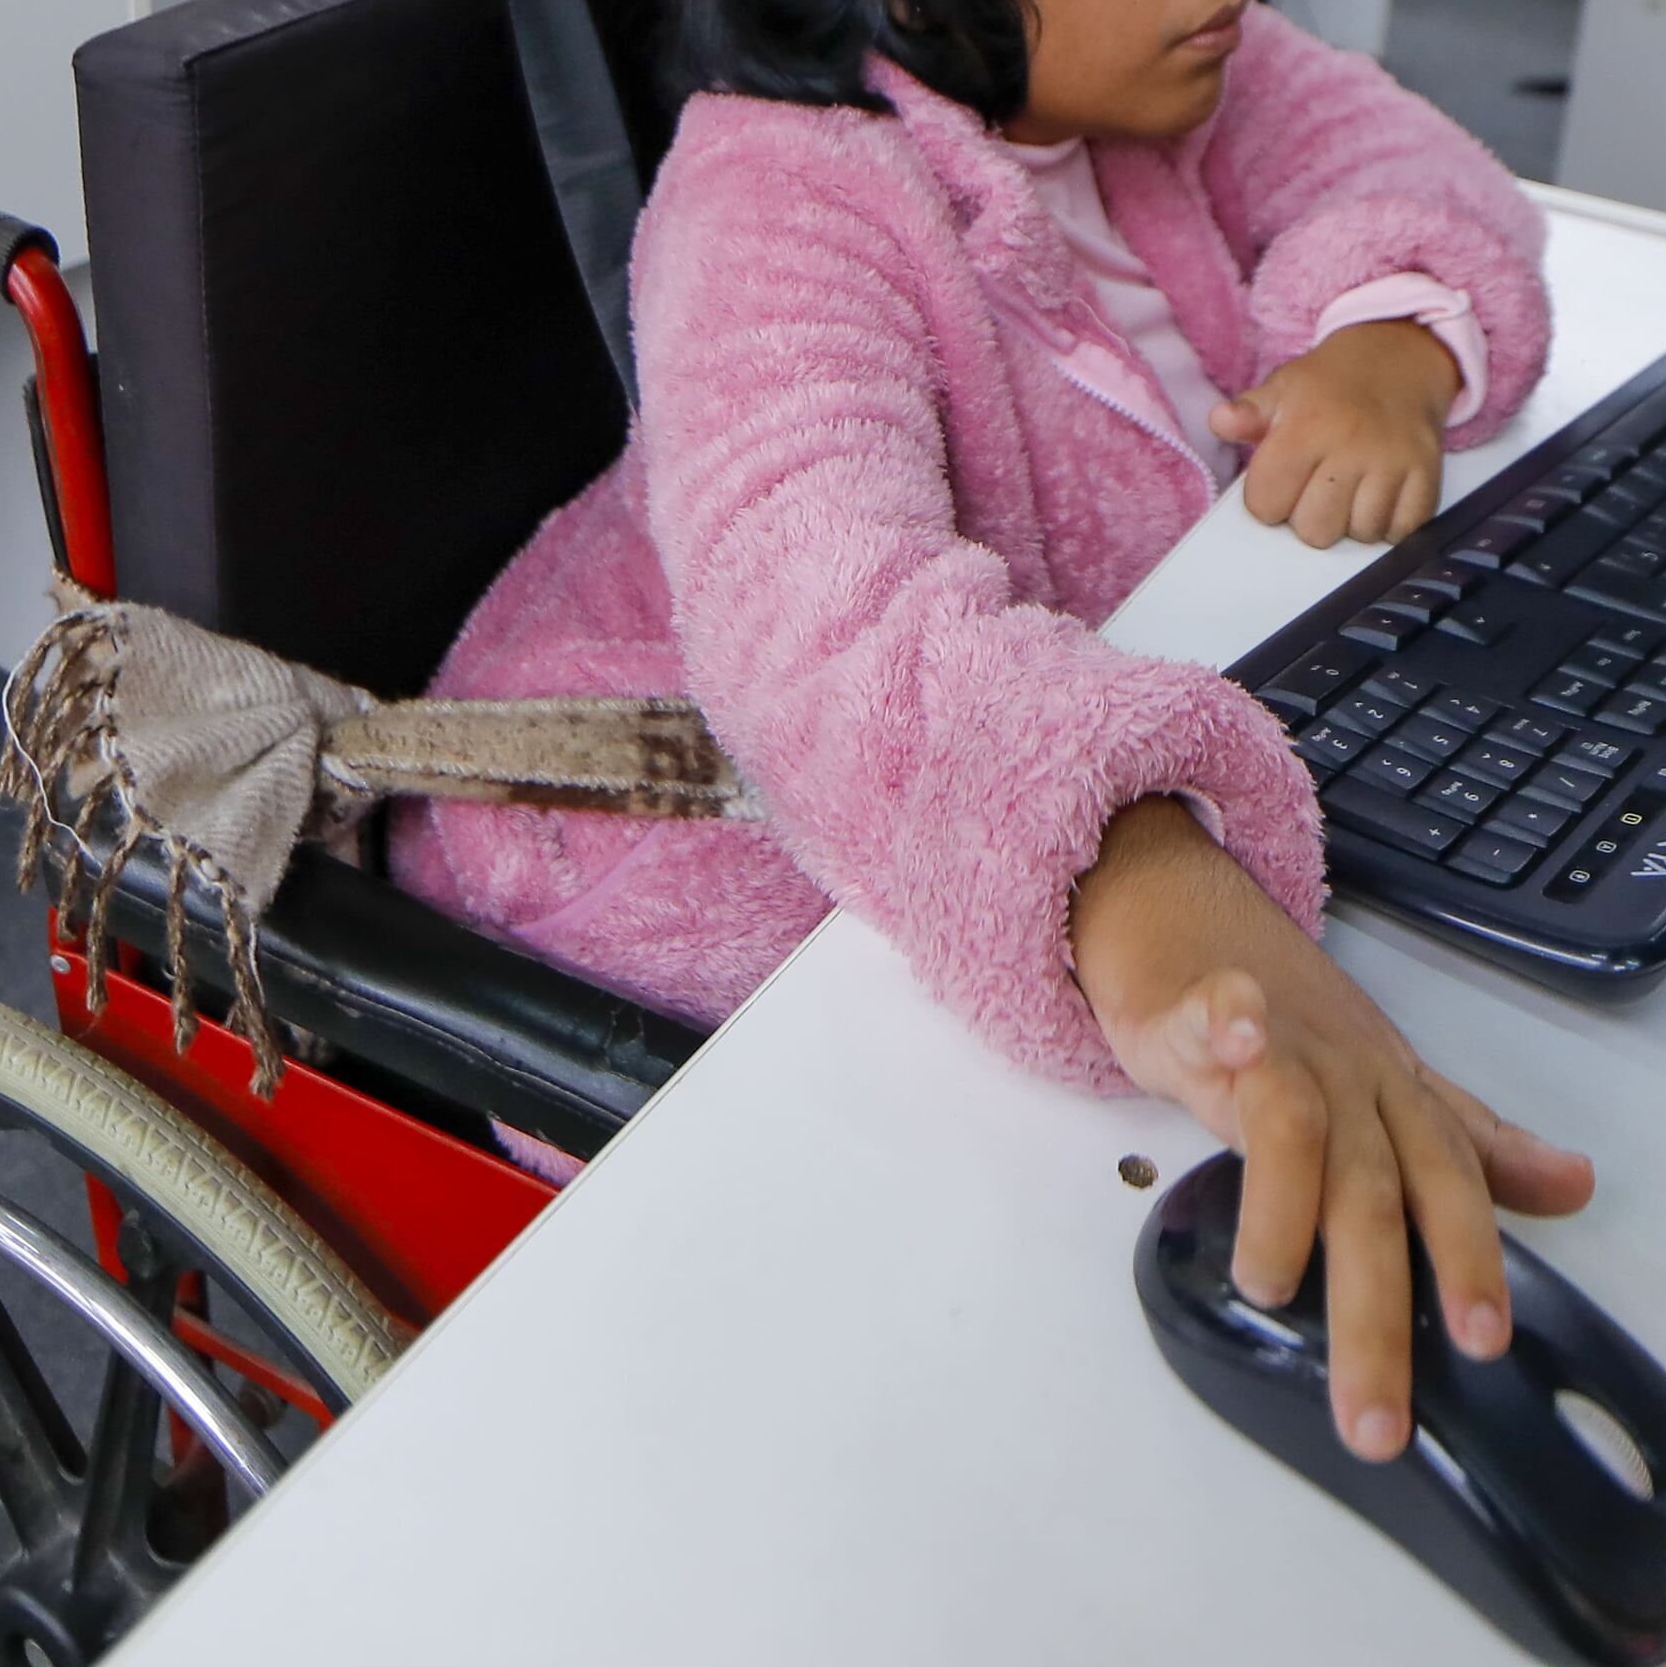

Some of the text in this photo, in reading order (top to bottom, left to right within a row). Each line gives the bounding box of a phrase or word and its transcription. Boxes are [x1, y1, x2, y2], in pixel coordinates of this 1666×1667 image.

[1403, 681, 1418, 690] 1
[1368, 708, 1384, 719] 2
[1465, 705, 1481, 714] 4
[1533, 728, 1548, 736] 7
[1333, 739, 1349, 750] 3
[1433, 735, 1449, 745] 5
[1499, 759, 1515, 768] 8
[1396, 767, 1412, 777] 6
[1464, 791, 1480, 801] 9
